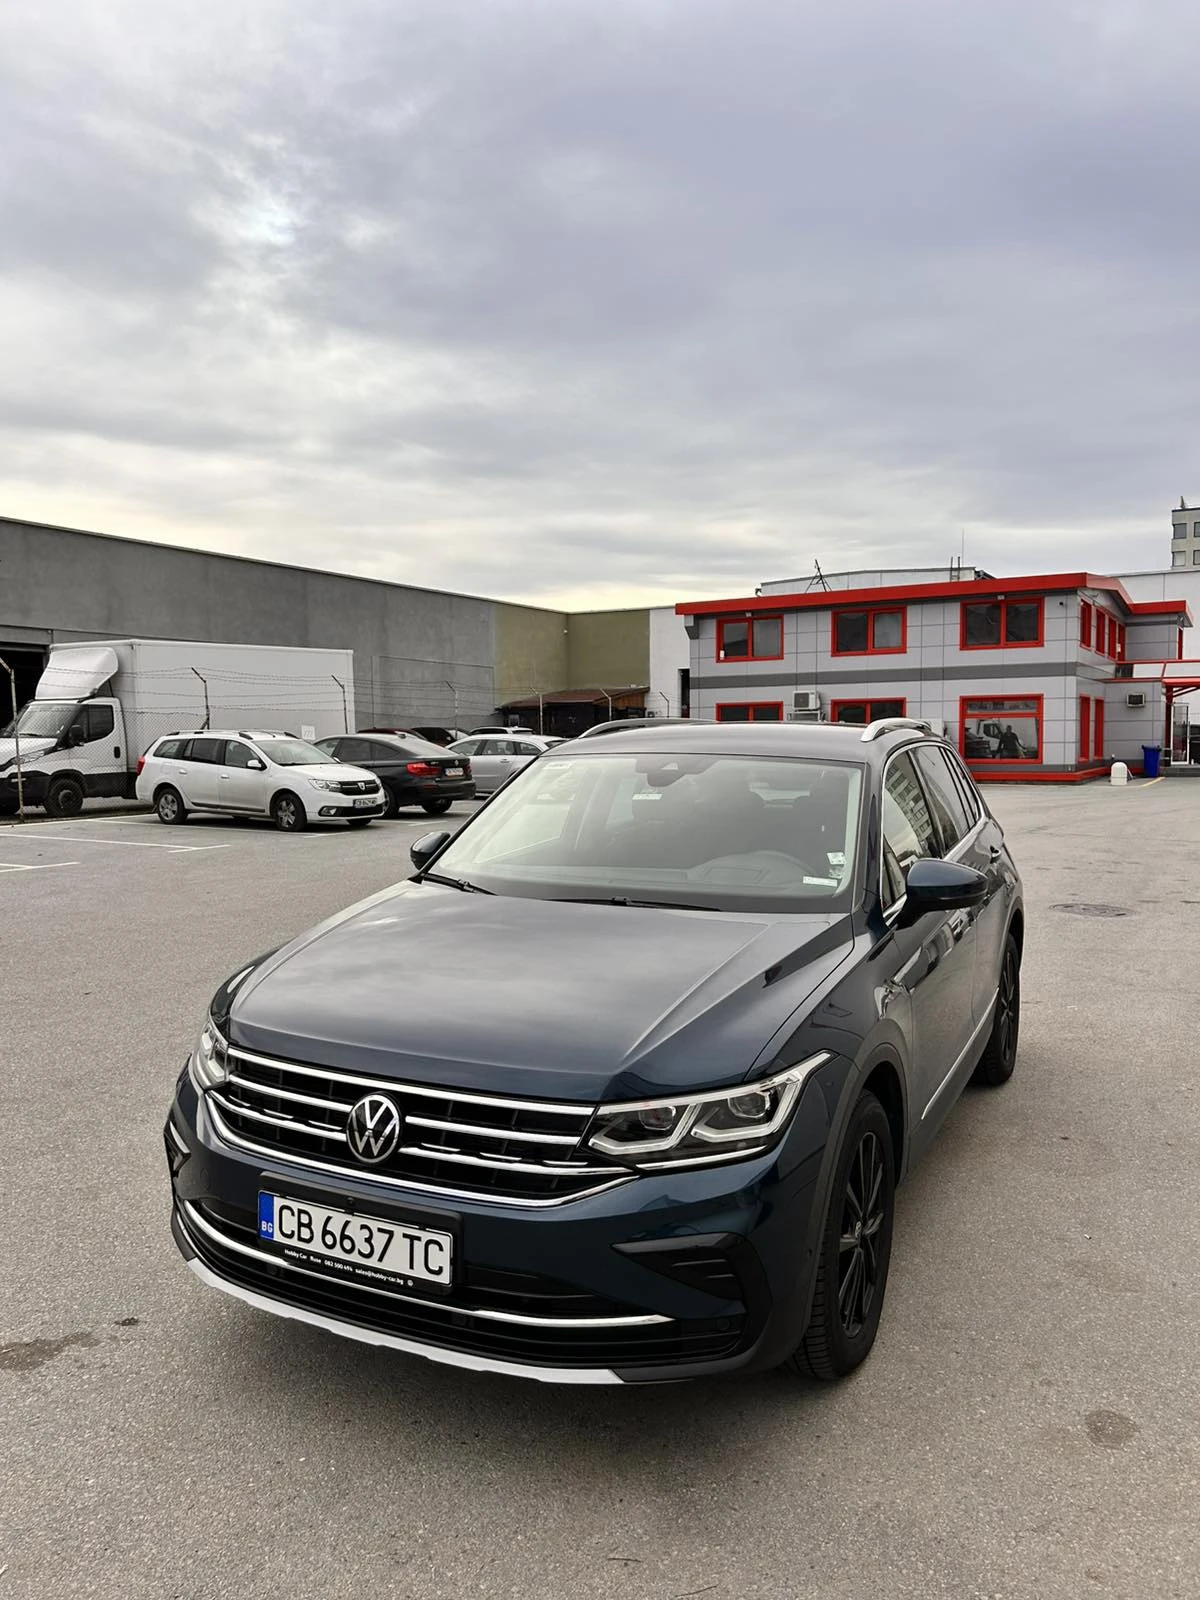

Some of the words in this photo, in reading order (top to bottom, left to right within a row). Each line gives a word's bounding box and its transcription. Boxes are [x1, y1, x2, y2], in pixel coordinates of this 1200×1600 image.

[261, 1221, 273, 1233] BG
[278, 1204, 314, 1244] CB
[321, 1215, 395, 1263] 6637
[402, 1232, 444, 1276] TC
